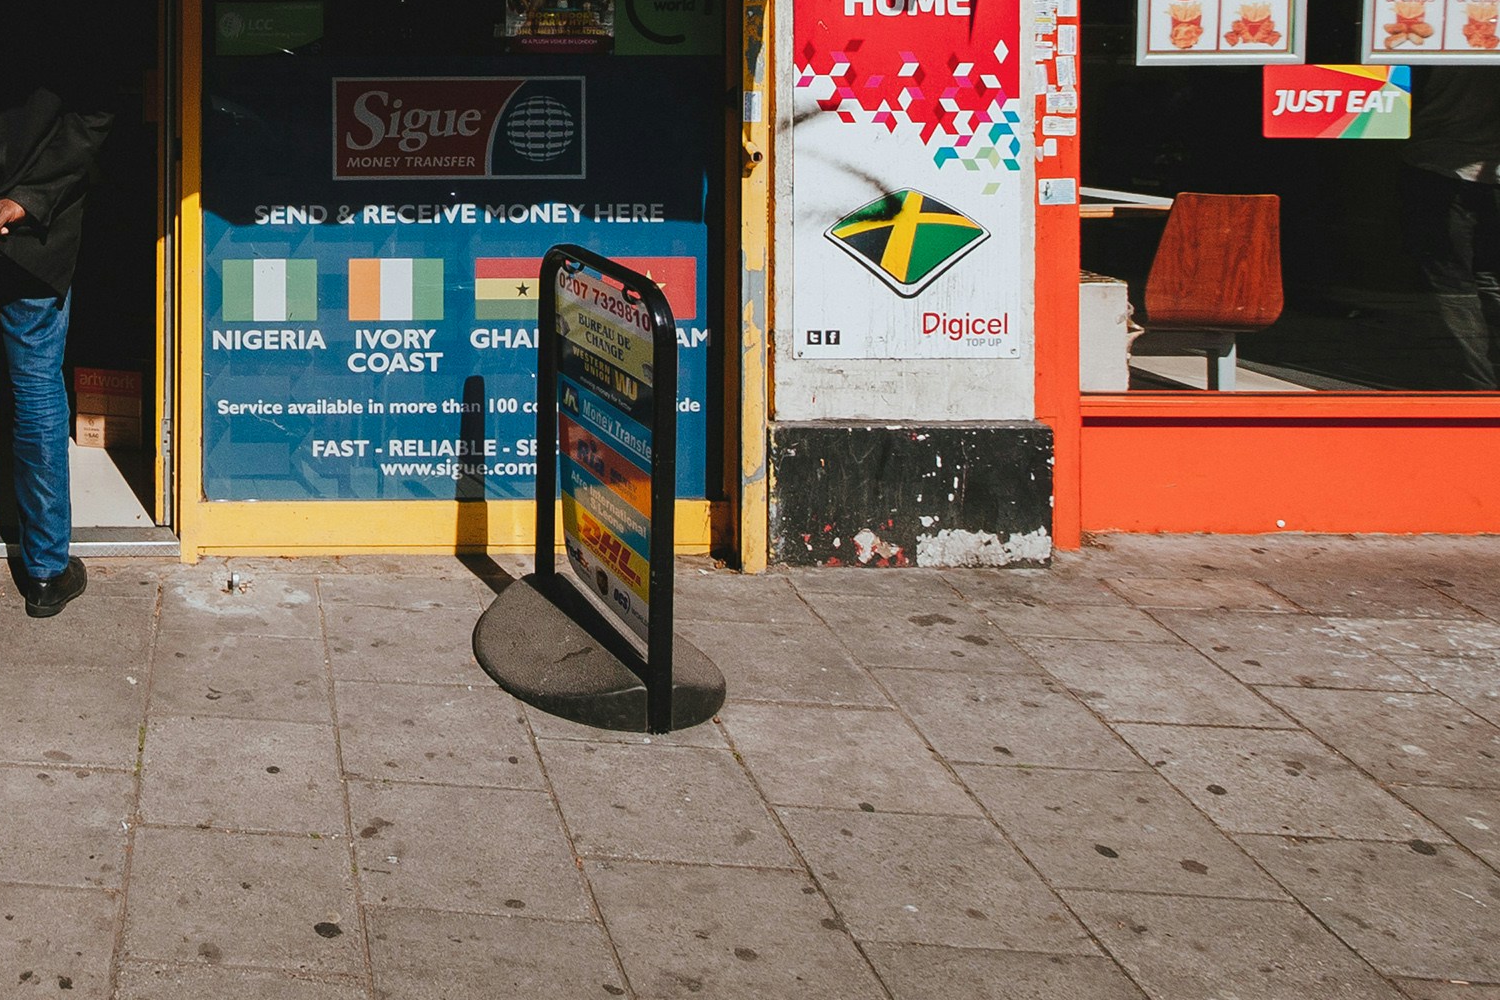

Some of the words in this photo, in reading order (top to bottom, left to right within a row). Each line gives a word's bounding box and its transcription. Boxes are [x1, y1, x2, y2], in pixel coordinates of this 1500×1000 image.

[1272, 89, 1344, 117] JUST
[1345, 89, 1401, 115] EAT
[345, 89, 482, 152] Sigue
[346, 156, 401, 169] MONEY
[404, 155, 476, 168] TRANSFER
[254, 203, 329, 226] SEND
[363, 203, 477, 225] RECEIVE
[484, 202, 586, 225] MONEY
[593, 202, 665, 224] HERE
[559, 272, 589, 300] 0207
[592, 287, 651, 333] 7329810
[211, 329, 327, 351] NIGERIA
[354, 328, 437, 351] IVORY
[578, 313, 615, 342] BUREAU
[617, 333, 631, 351] DE
[922, 312, 1009, 342] Digicel
[585, 330, 624, 362] CHANGE
[965, 338, 986, 347] TOP
[987, 338, 1003, 347] UP
[346, 351, 444, 374] COAST
[572, 345, 611, 375] WESTERN
[217, 399, 283, 415] Service
[287, 398, 364, 415] available
[367, 399, 384, 414] in
[388, 401, 440, 414] more
[441, 398, 481, 414] than
[488, 398, 518, 413] 100
[582, 399, 613, 433] Money
[312, 439, 370, 458] FAST
[388, 439, 497, 457] RELIABLE
